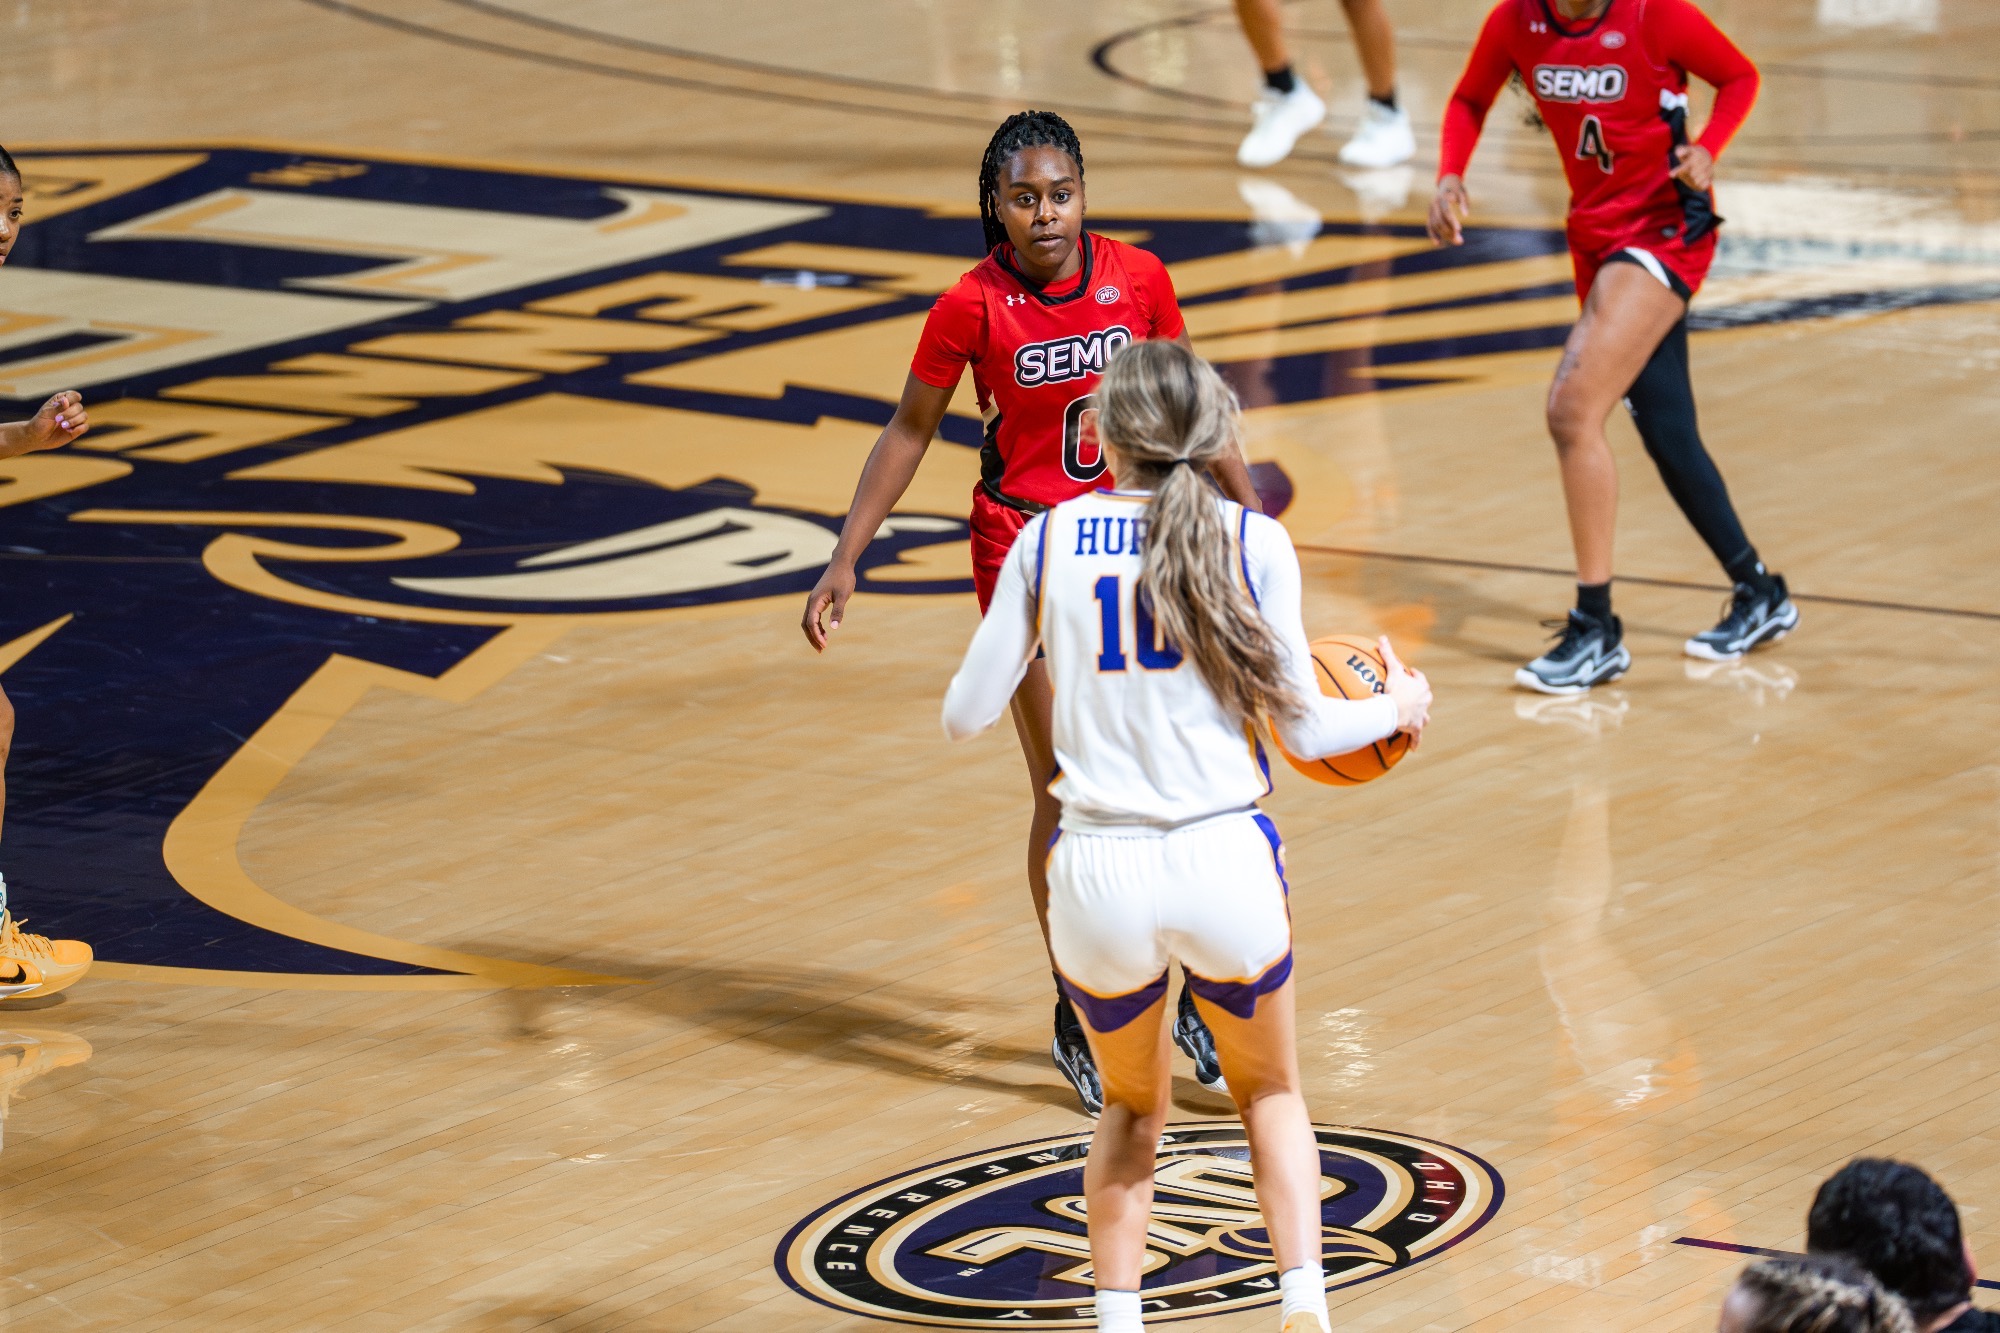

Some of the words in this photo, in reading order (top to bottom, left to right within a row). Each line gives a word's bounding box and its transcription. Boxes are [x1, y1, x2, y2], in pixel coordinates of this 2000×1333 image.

[1534, 66, 1626, 101] SEMO
[1576, 114, 1614, 175] 4
[1016, 326, 1131, 386] SEMO
[1093, 575, 1186, 673] 10
[826, 1135, 1176, 1272] NFERENCE
[1407, 1162, 1455, 1223] OHIO
[994, 1268, 1329, 1319] ALLEY
